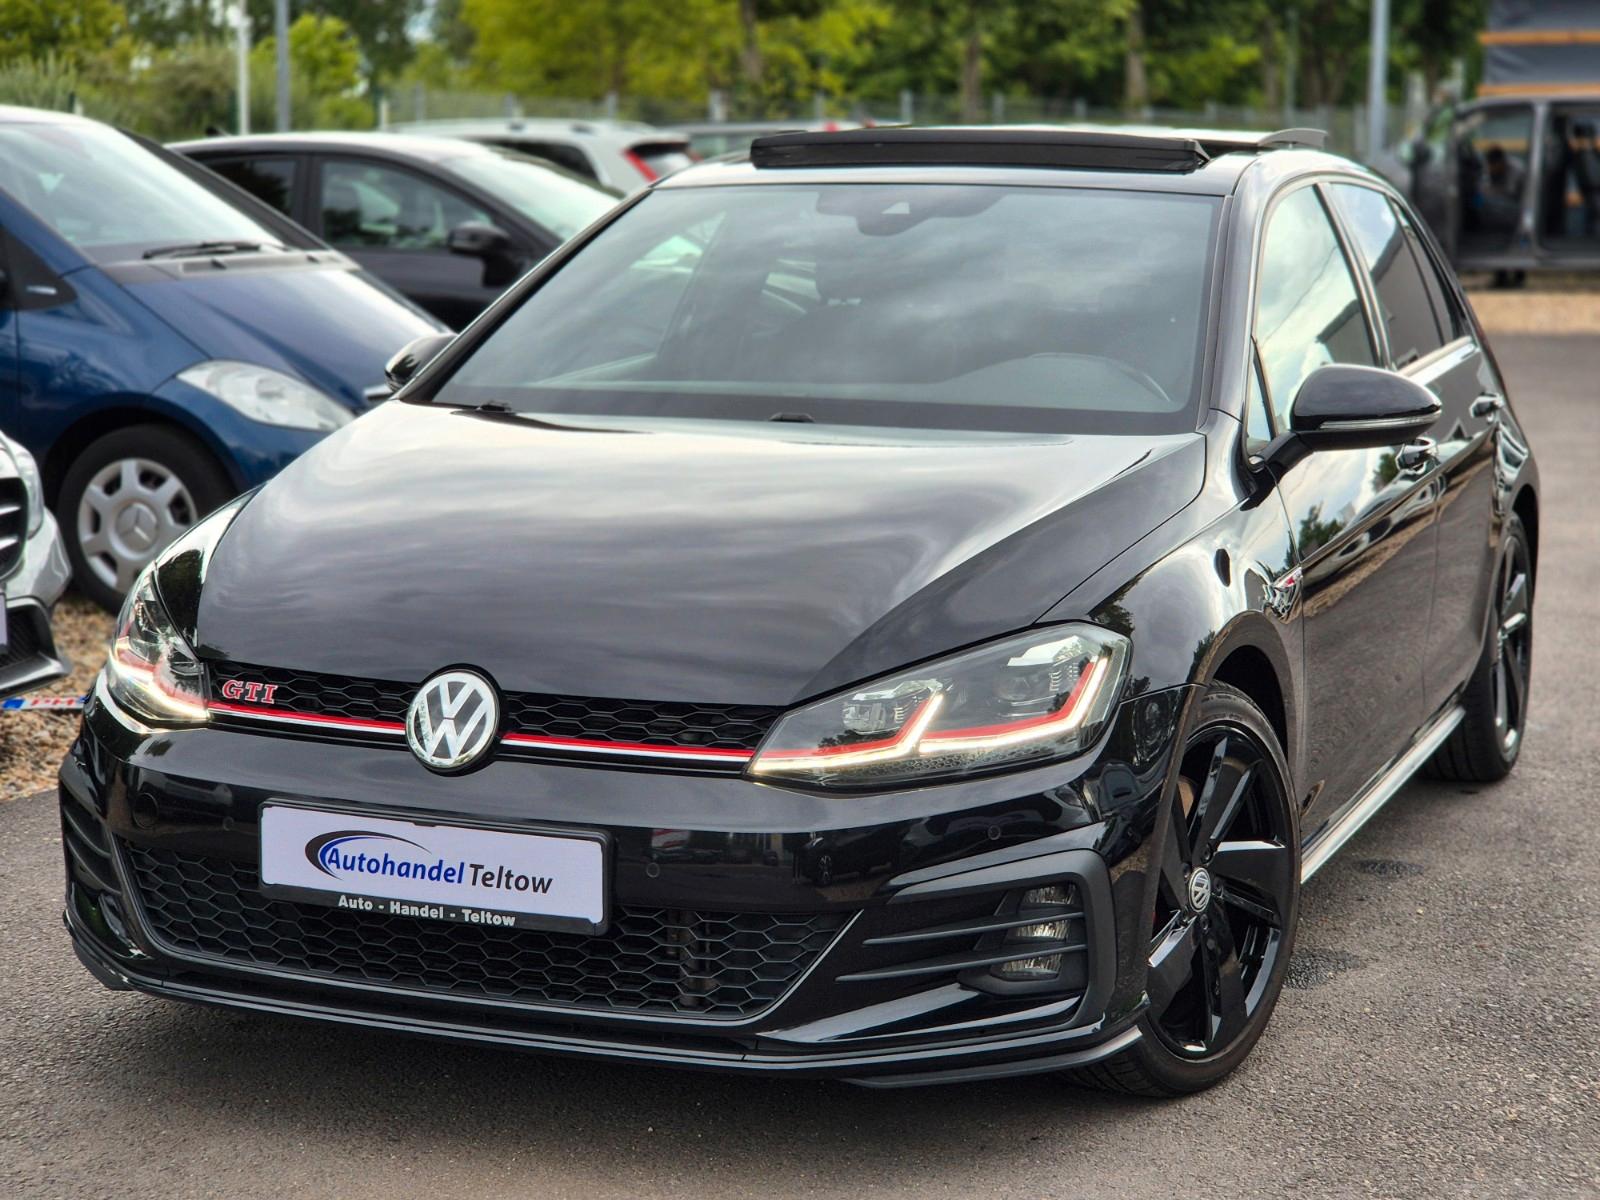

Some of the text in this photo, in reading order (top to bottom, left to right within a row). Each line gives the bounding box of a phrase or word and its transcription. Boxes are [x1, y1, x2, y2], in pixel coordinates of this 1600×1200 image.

[222, 679, 278, 704] GTI
[408, 670, 496, 768] VW
[327, 848, 553, 894] Autohandel Teltow
[338, 895, 373, 911] Auto
[390, 901, 444, 919] Handel
[462, 908, 516, 926] Teltow
